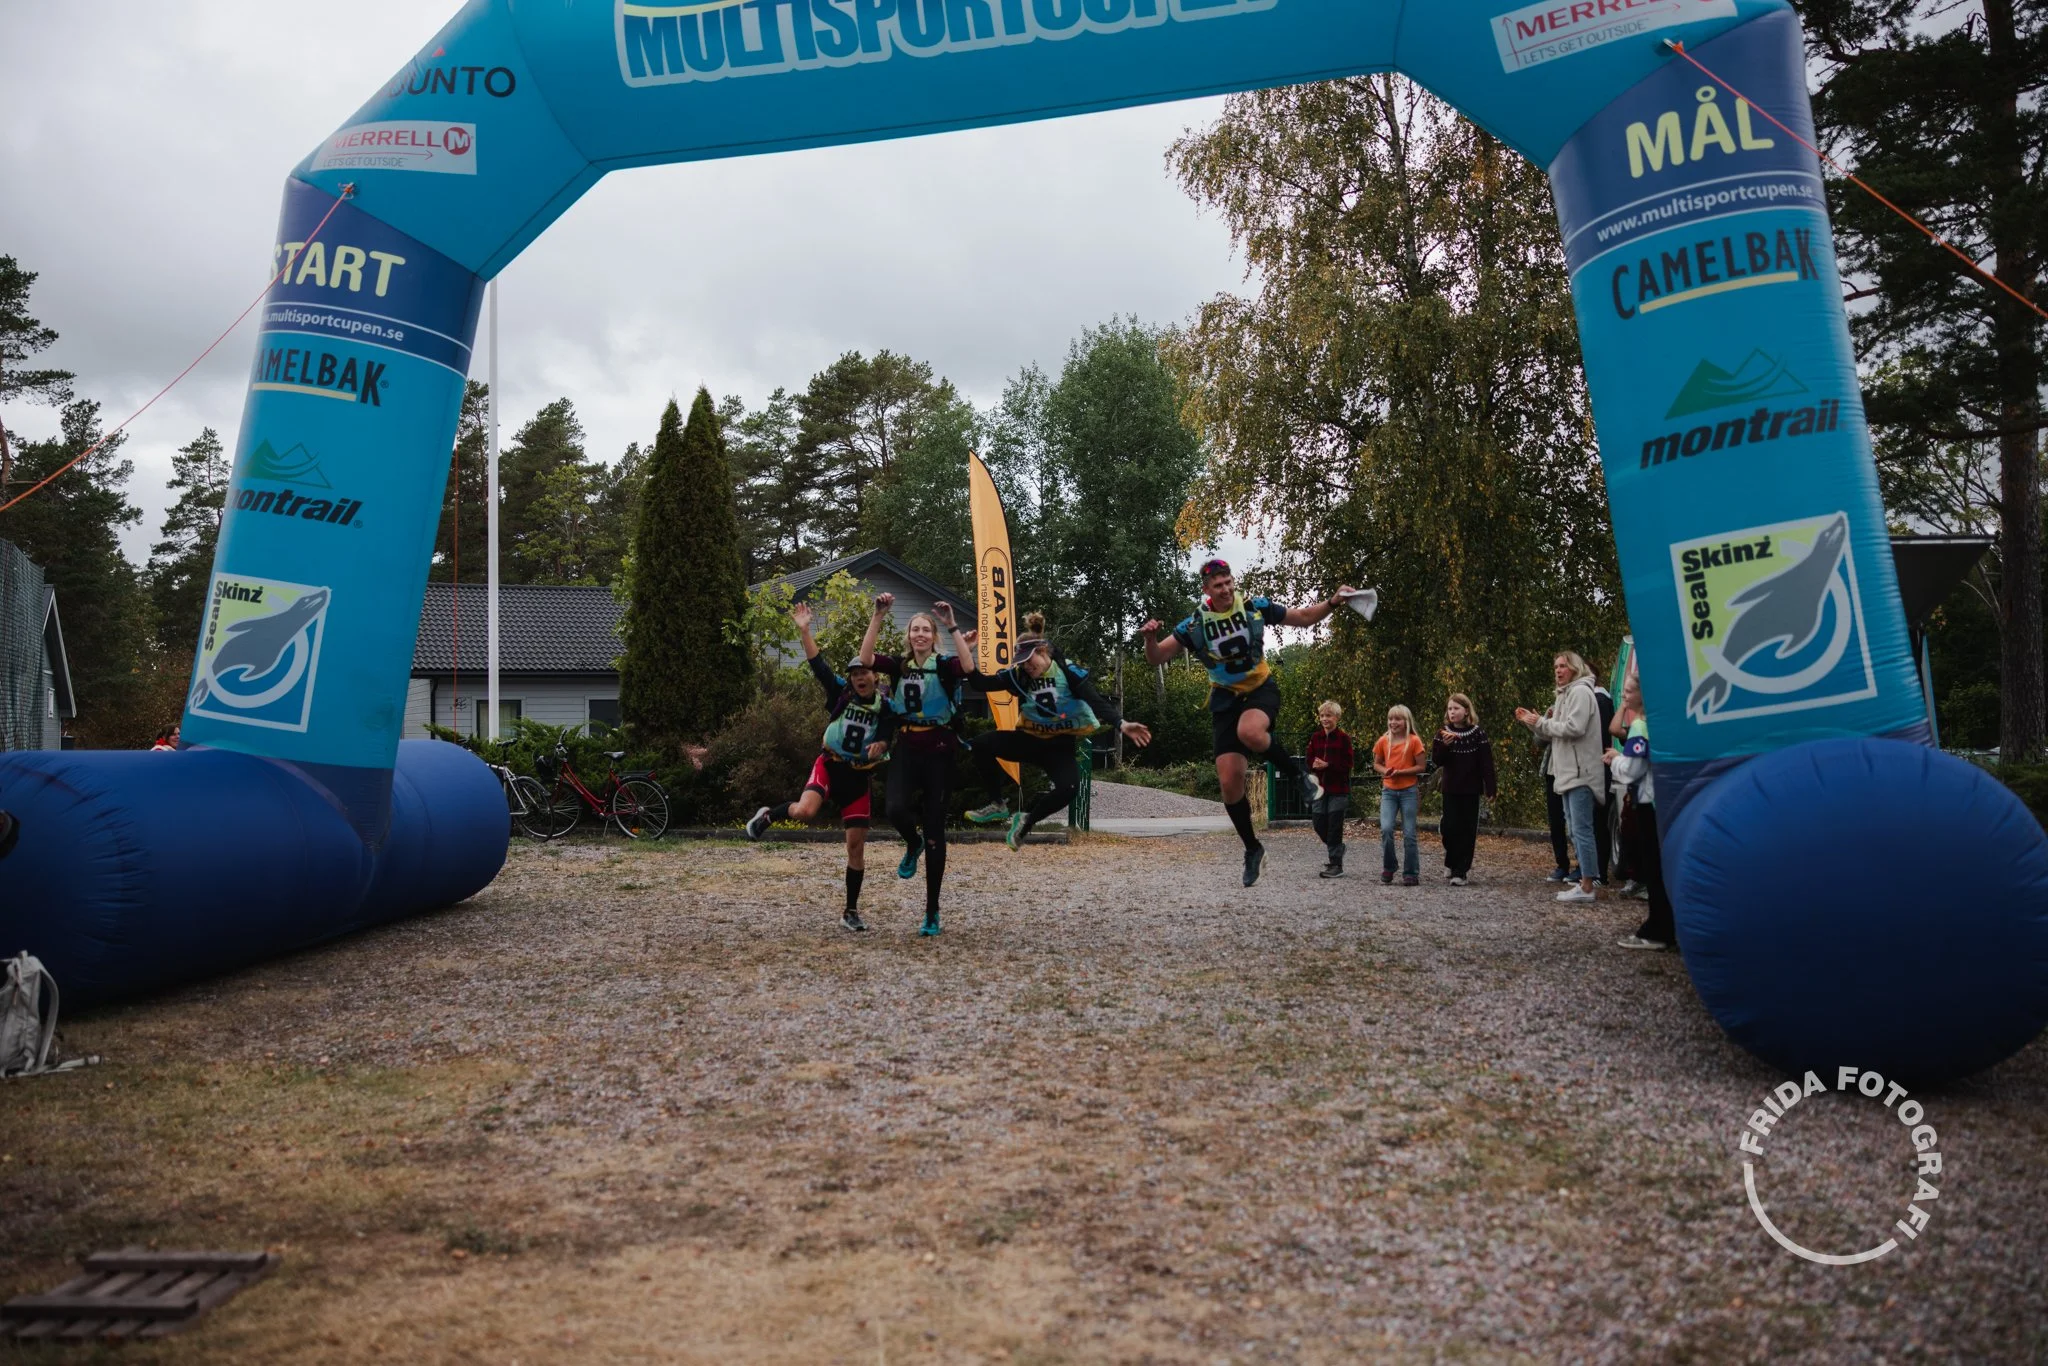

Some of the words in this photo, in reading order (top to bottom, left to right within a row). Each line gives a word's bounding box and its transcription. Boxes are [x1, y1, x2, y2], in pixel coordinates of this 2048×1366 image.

[1523, 46, 1556, 65] LET'S
[1559, 38, 1585, 53] GET
[1587, 21, 1646, 45] OUTSIDE
[335, 129, 442, 148] MERRELL
[1625, 86, 1775, 178] MÅL
[363, 156, 404, 168] OUTSIDE
[1597, 184, 1813, 242] www.multisportcupen.se
[1612, 228, 1820, 320] CAMELBAK
[254, 347, 387, 407] AMELBAK
[1640, 399, 1840, 470] montrail
[205, 599, 222, 651] Seal
[1684, 571, 1714, 640] Seal
[904, 683, 922, 713] 8
[841, 724, 866, 754] 8
